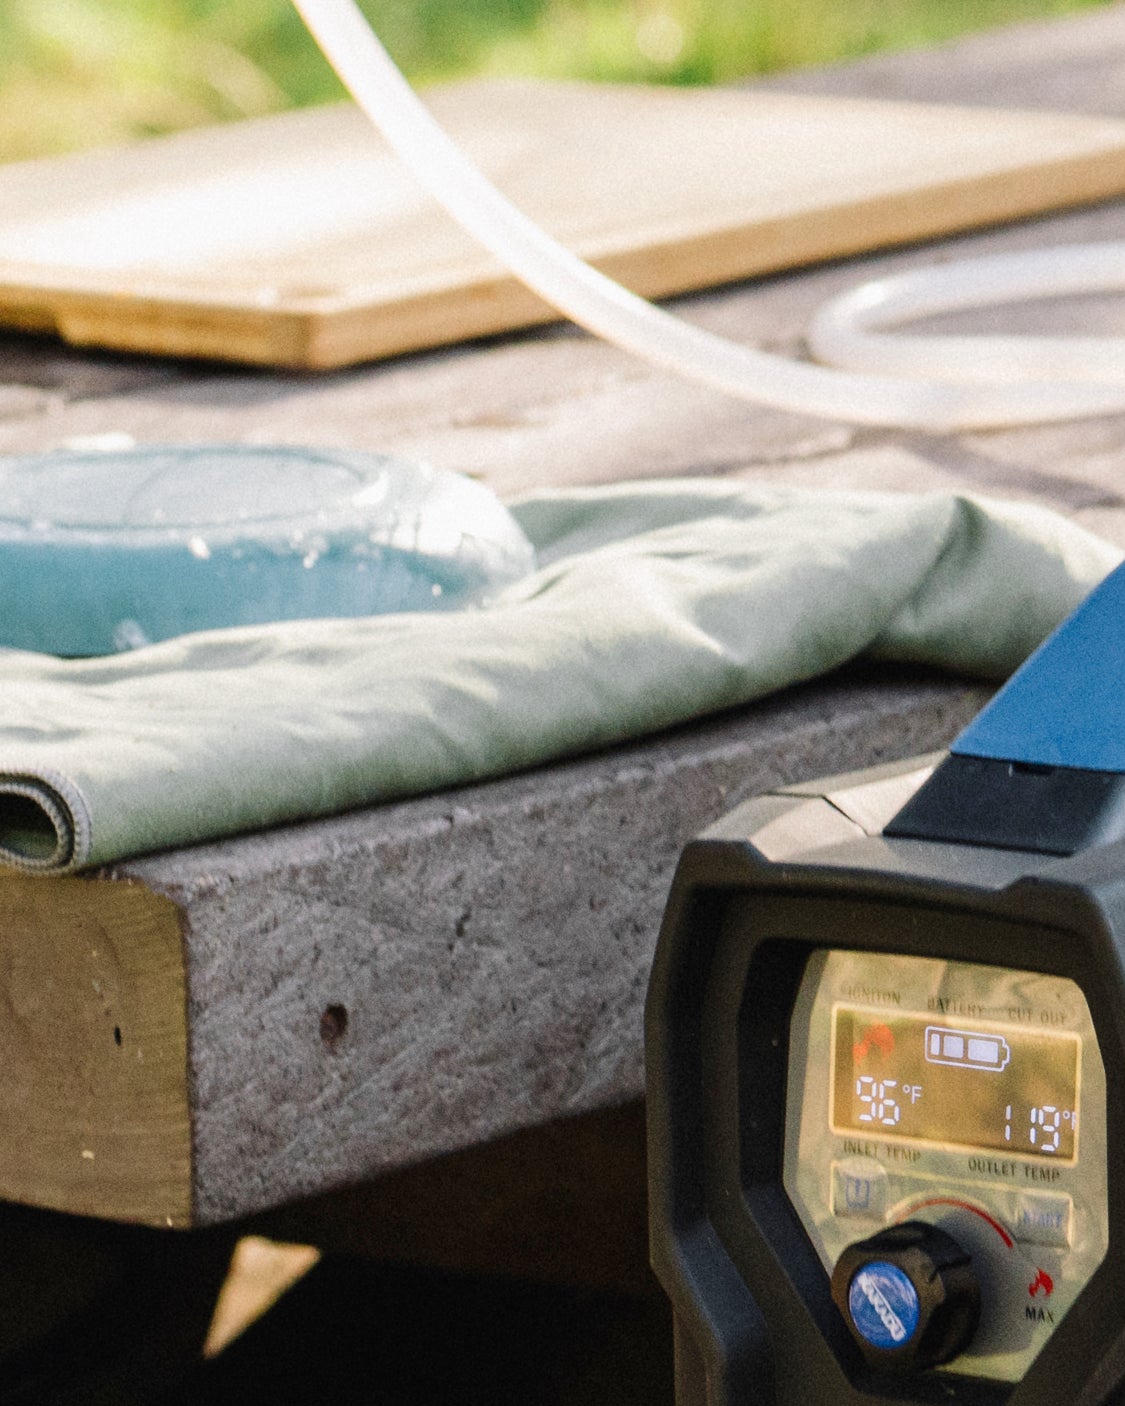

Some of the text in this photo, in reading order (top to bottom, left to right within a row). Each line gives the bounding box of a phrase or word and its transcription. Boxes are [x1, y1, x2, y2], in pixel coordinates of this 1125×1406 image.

[886, 1144, 922, 1164] TEMP
[968, 1158, 1061, 1183] OUTLET TEMP
